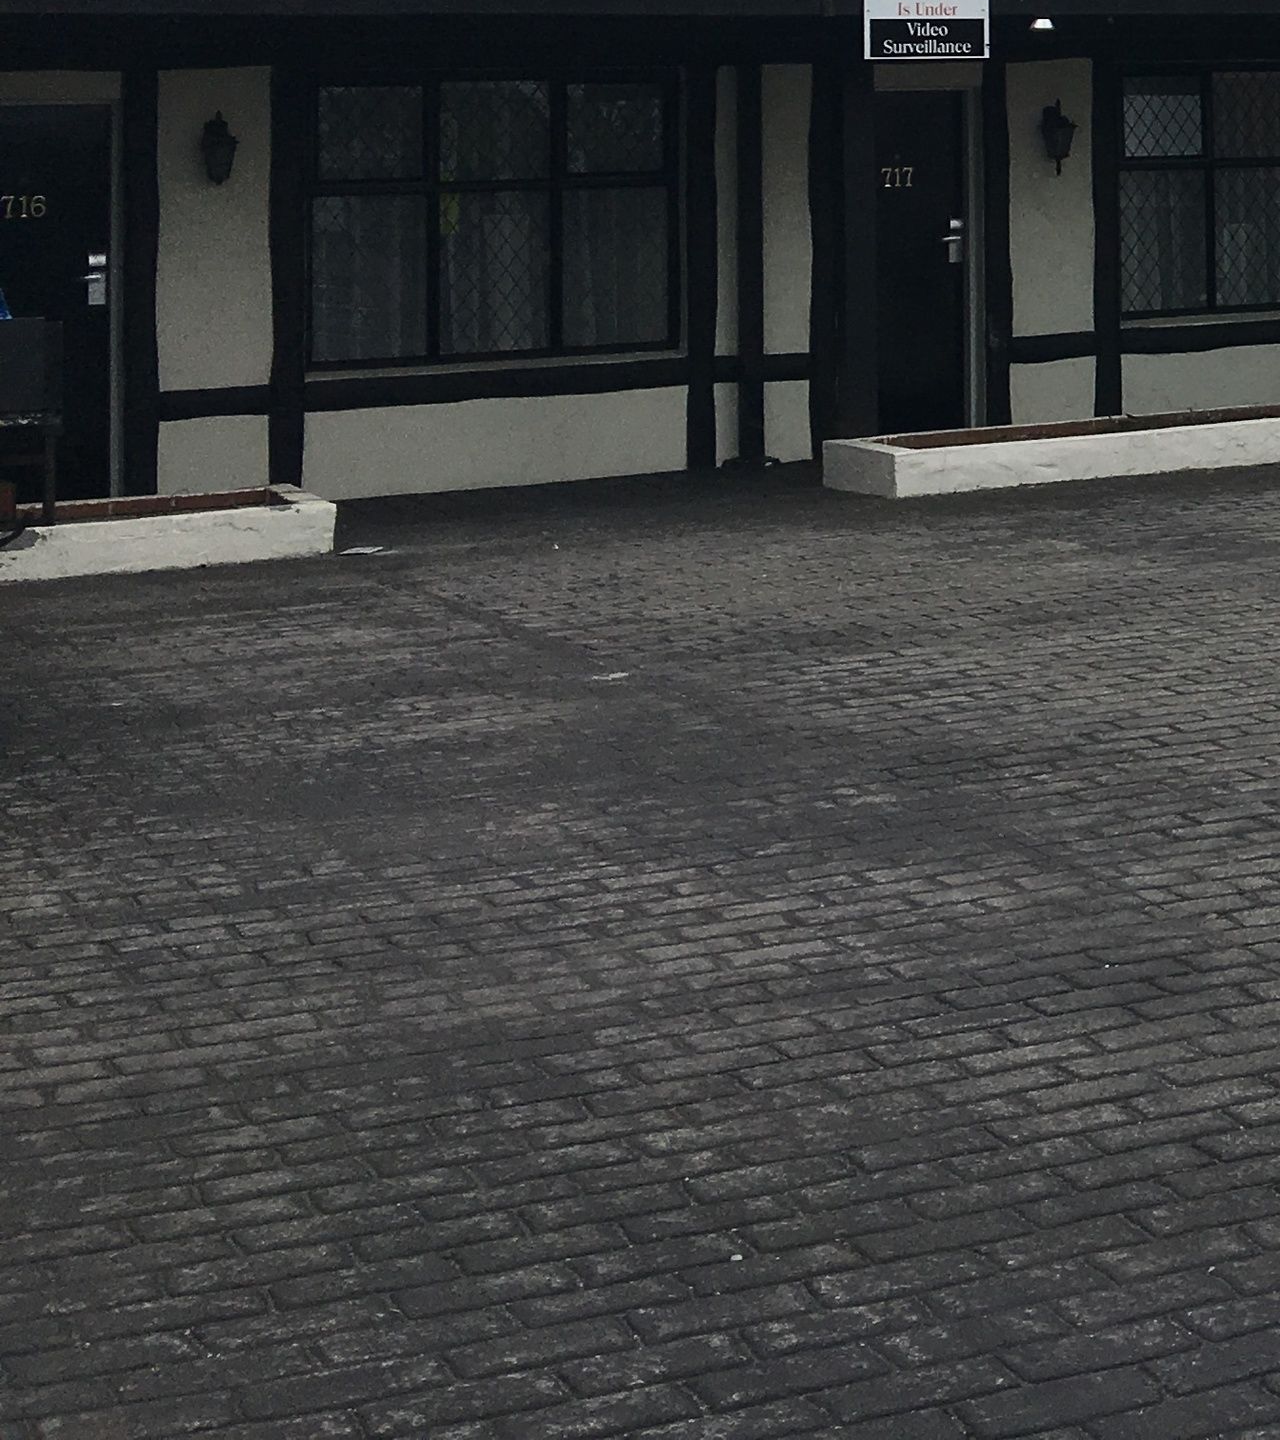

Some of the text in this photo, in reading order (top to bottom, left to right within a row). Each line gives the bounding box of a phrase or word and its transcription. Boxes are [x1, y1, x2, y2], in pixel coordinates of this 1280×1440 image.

[898, 2, 958, 16] Is Under
[907, 22, 949, 37] Video
[883, 39, 972, 54] Surveillance
[880, 166, 913, 187] 717
[1, 195, 47, 218] 716
